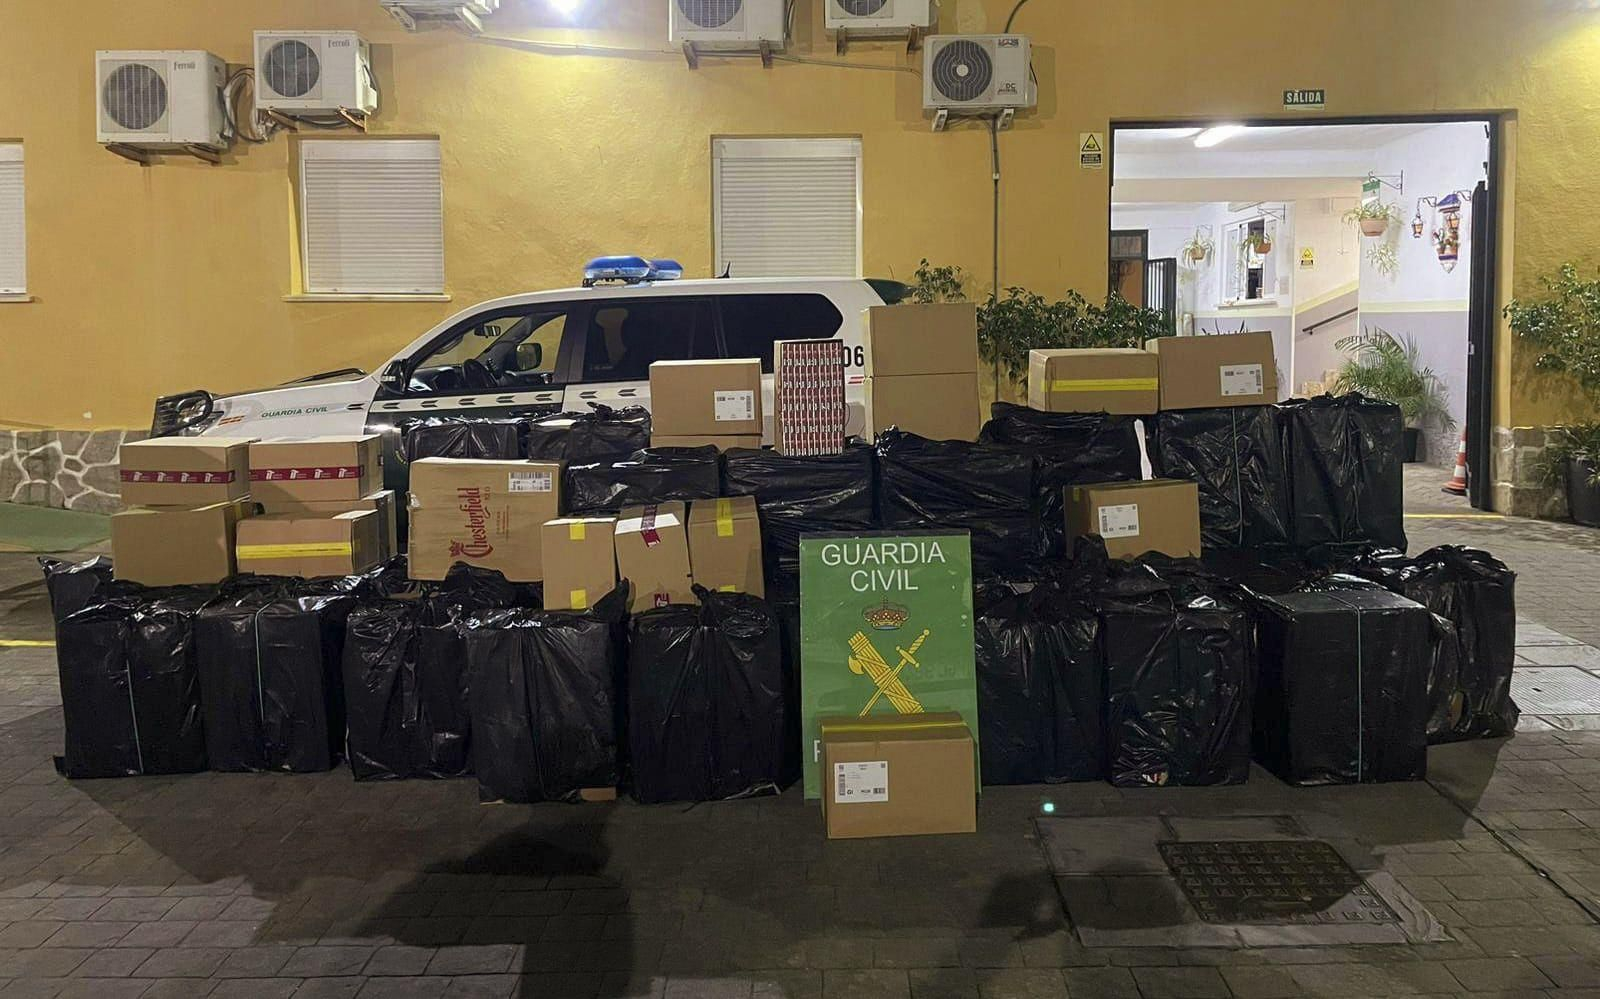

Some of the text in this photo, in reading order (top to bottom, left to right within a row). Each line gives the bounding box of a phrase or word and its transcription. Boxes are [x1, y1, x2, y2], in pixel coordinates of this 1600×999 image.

[1286, 92, 1321, 103] SALIDA
[261, 406, 328, 418] GUARDIA CIVIL
[457, 487, 494, 558] Chesterfield
[821, 541, 946, 566] GUARDIA
[850, 569, 919, 592] CIVIL
